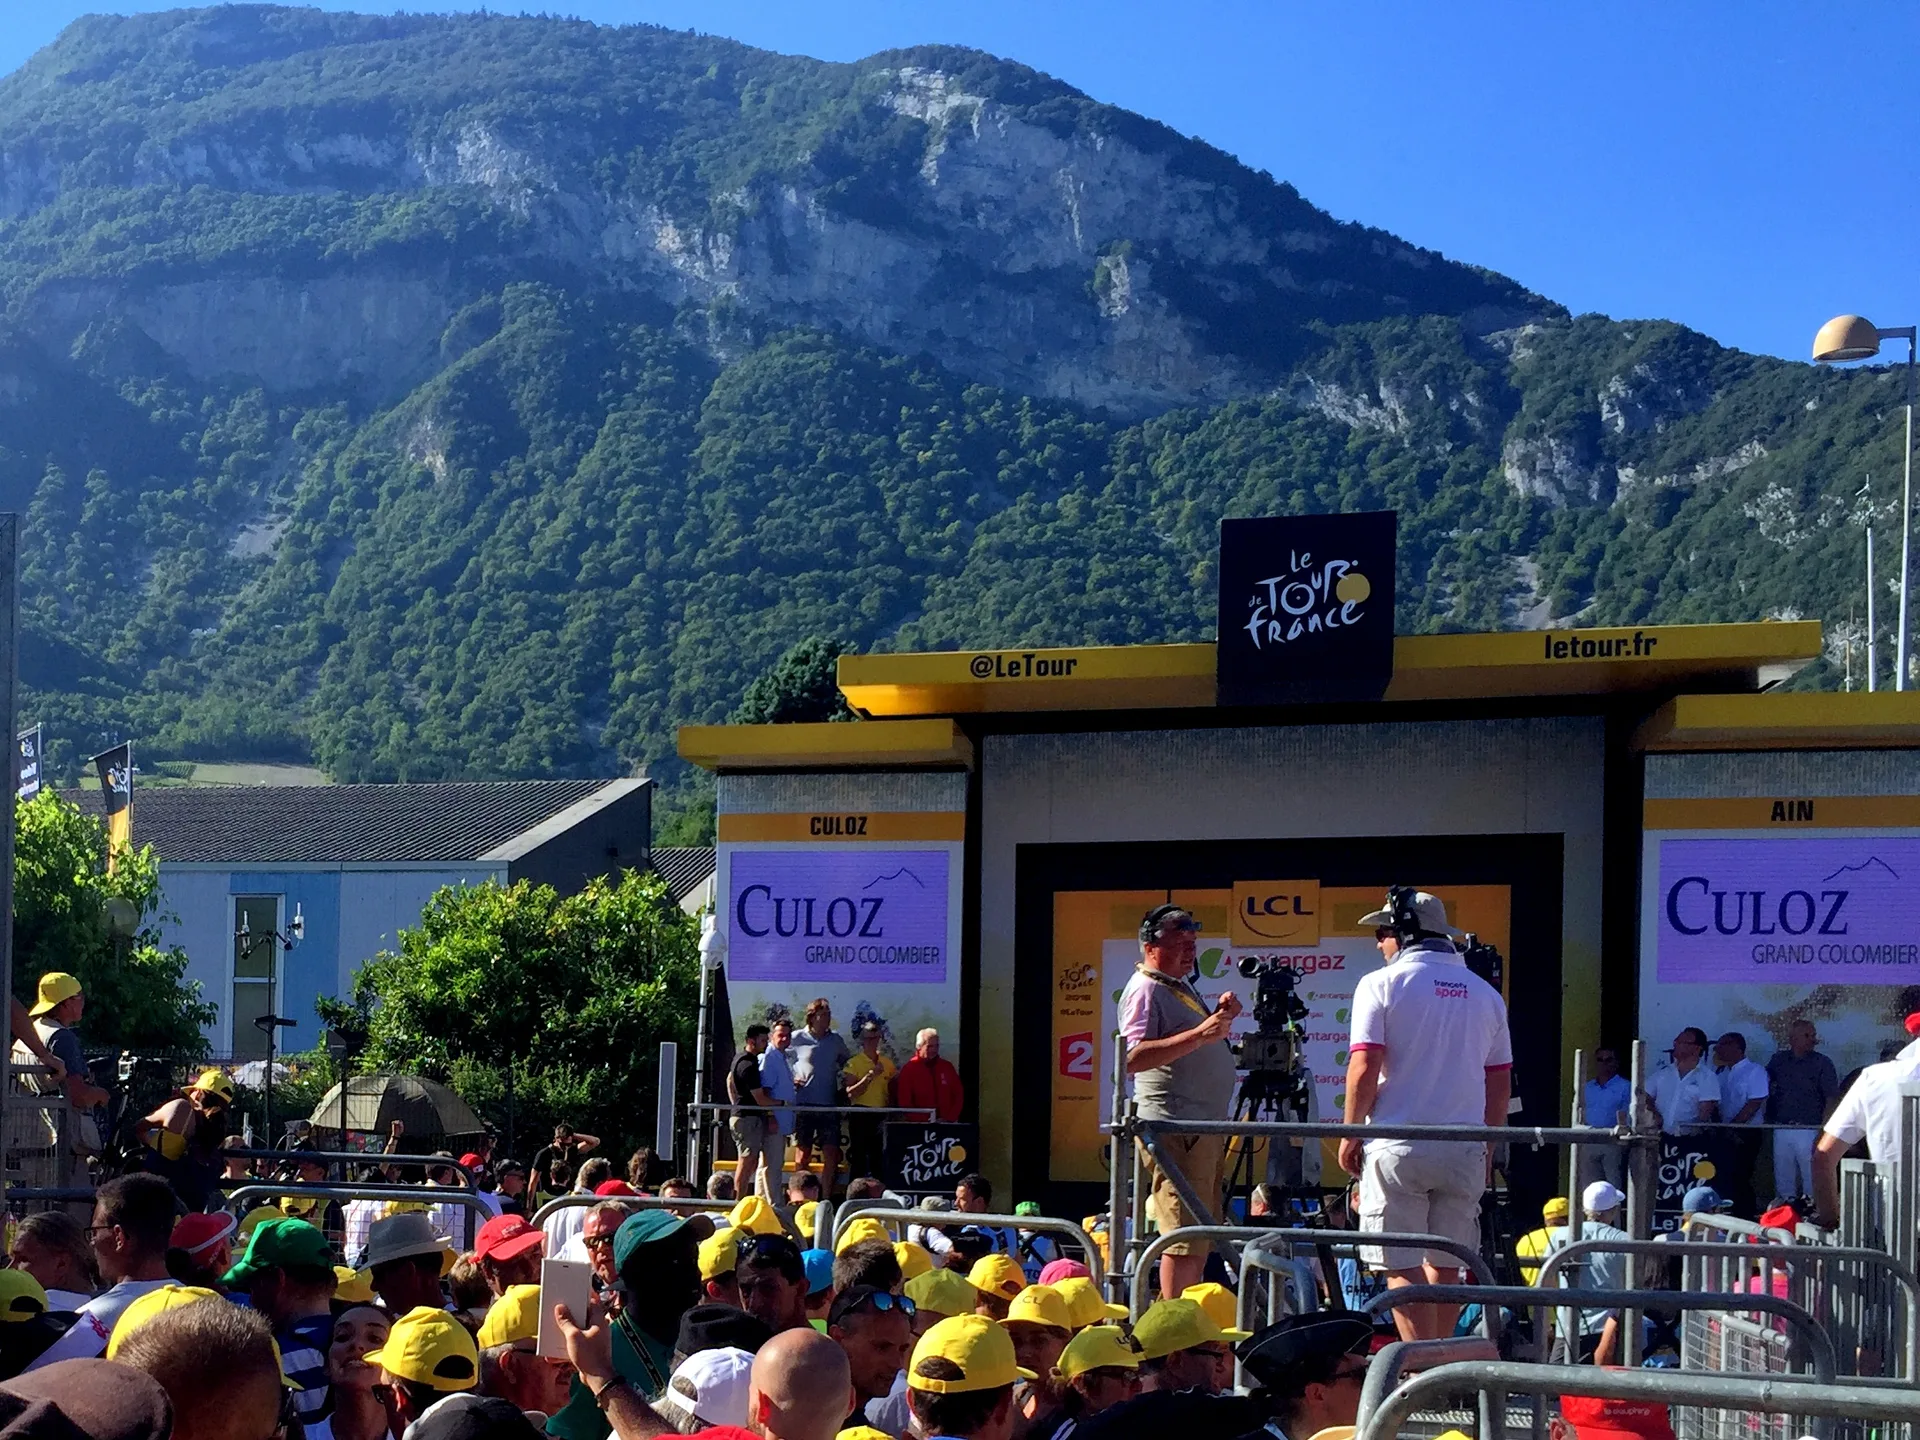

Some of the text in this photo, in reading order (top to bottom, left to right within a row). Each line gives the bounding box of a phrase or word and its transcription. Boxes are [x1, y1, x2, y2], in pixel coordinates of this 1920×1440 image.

[1248, 595, 1262, 607] de
[1545, 631, 1658, 659] letour.fr
[970, 654, 1078, 678] @LeTour
[1771, 800, 1814, 821] AIN
[810, 816, 868, 836] CULOZ
[1247, 896, 1314, 916] LCL
[805, 945, 941, 965] GRAND COLOMBIER
[1752, 944, 1919, 965] GRAND COLOMBIER
[1435, 987, 1468, 999] sport
[1067, 1040, 1092, 1073] 2
